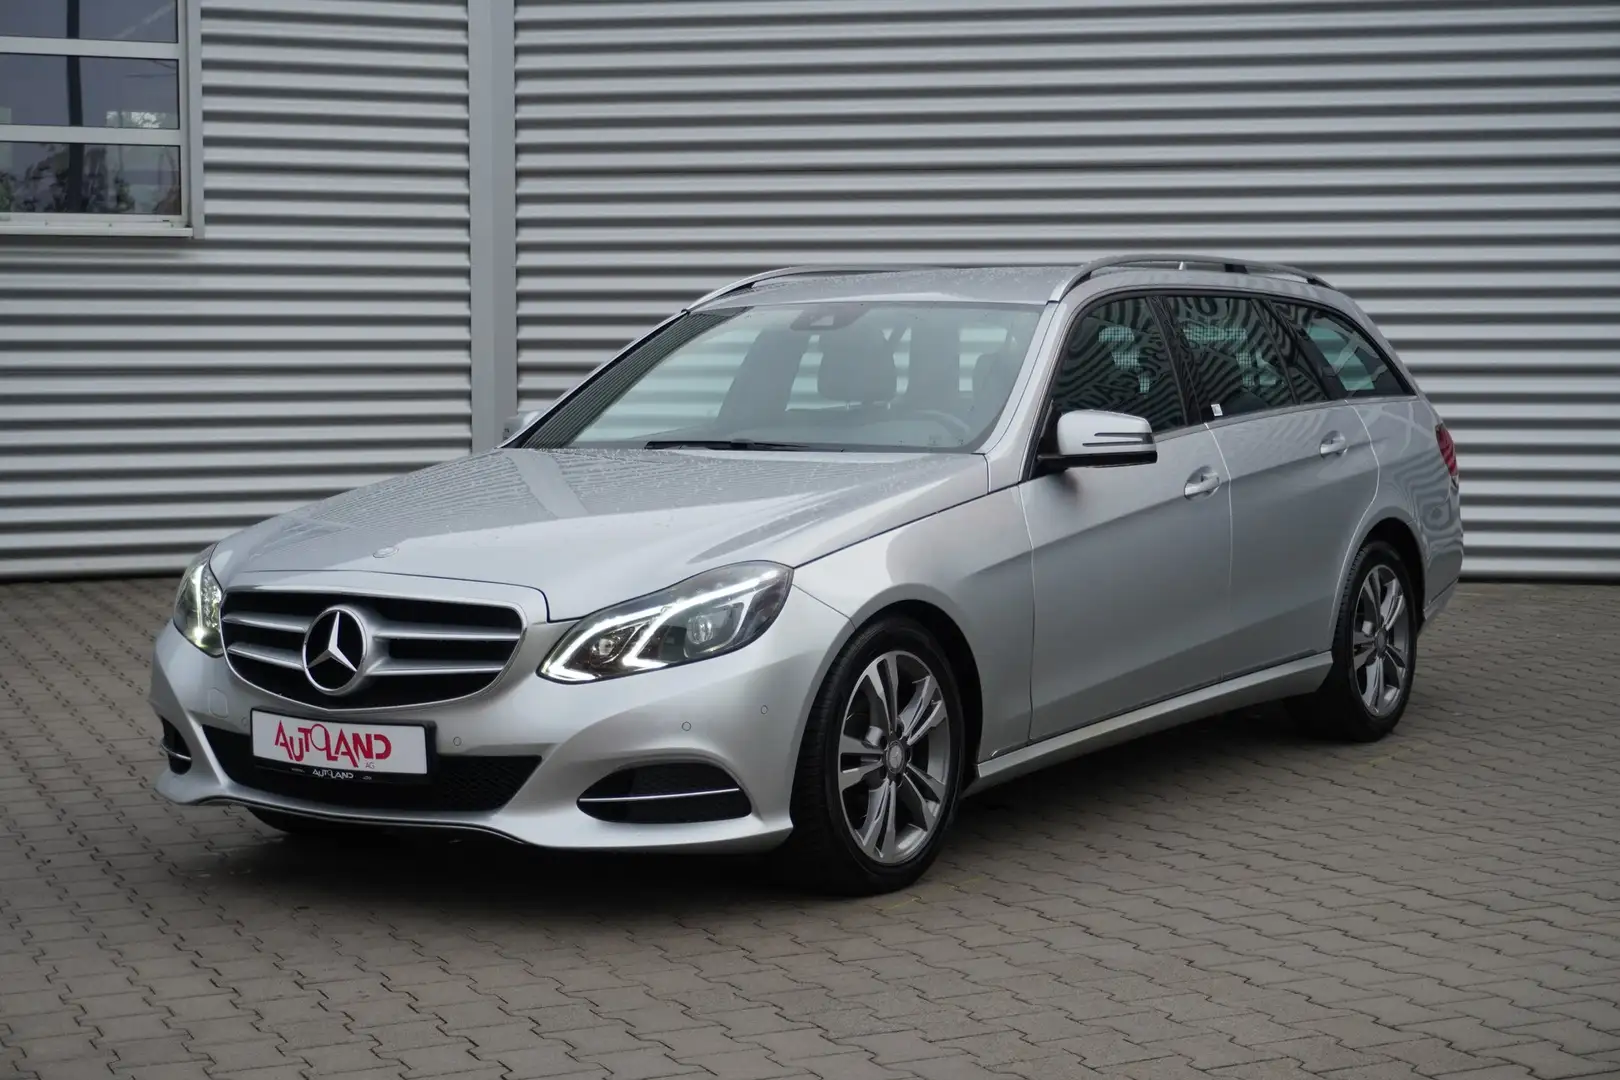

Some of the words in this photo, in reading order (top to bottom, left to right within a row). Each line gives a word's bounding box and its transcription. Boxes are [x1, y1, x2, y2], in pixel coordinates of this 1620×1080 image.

[274, 720, 392, 768] AUTOLAND
[365, 761, 375, 769] AG
[312, 769, 354, 779] AUTOLAND
